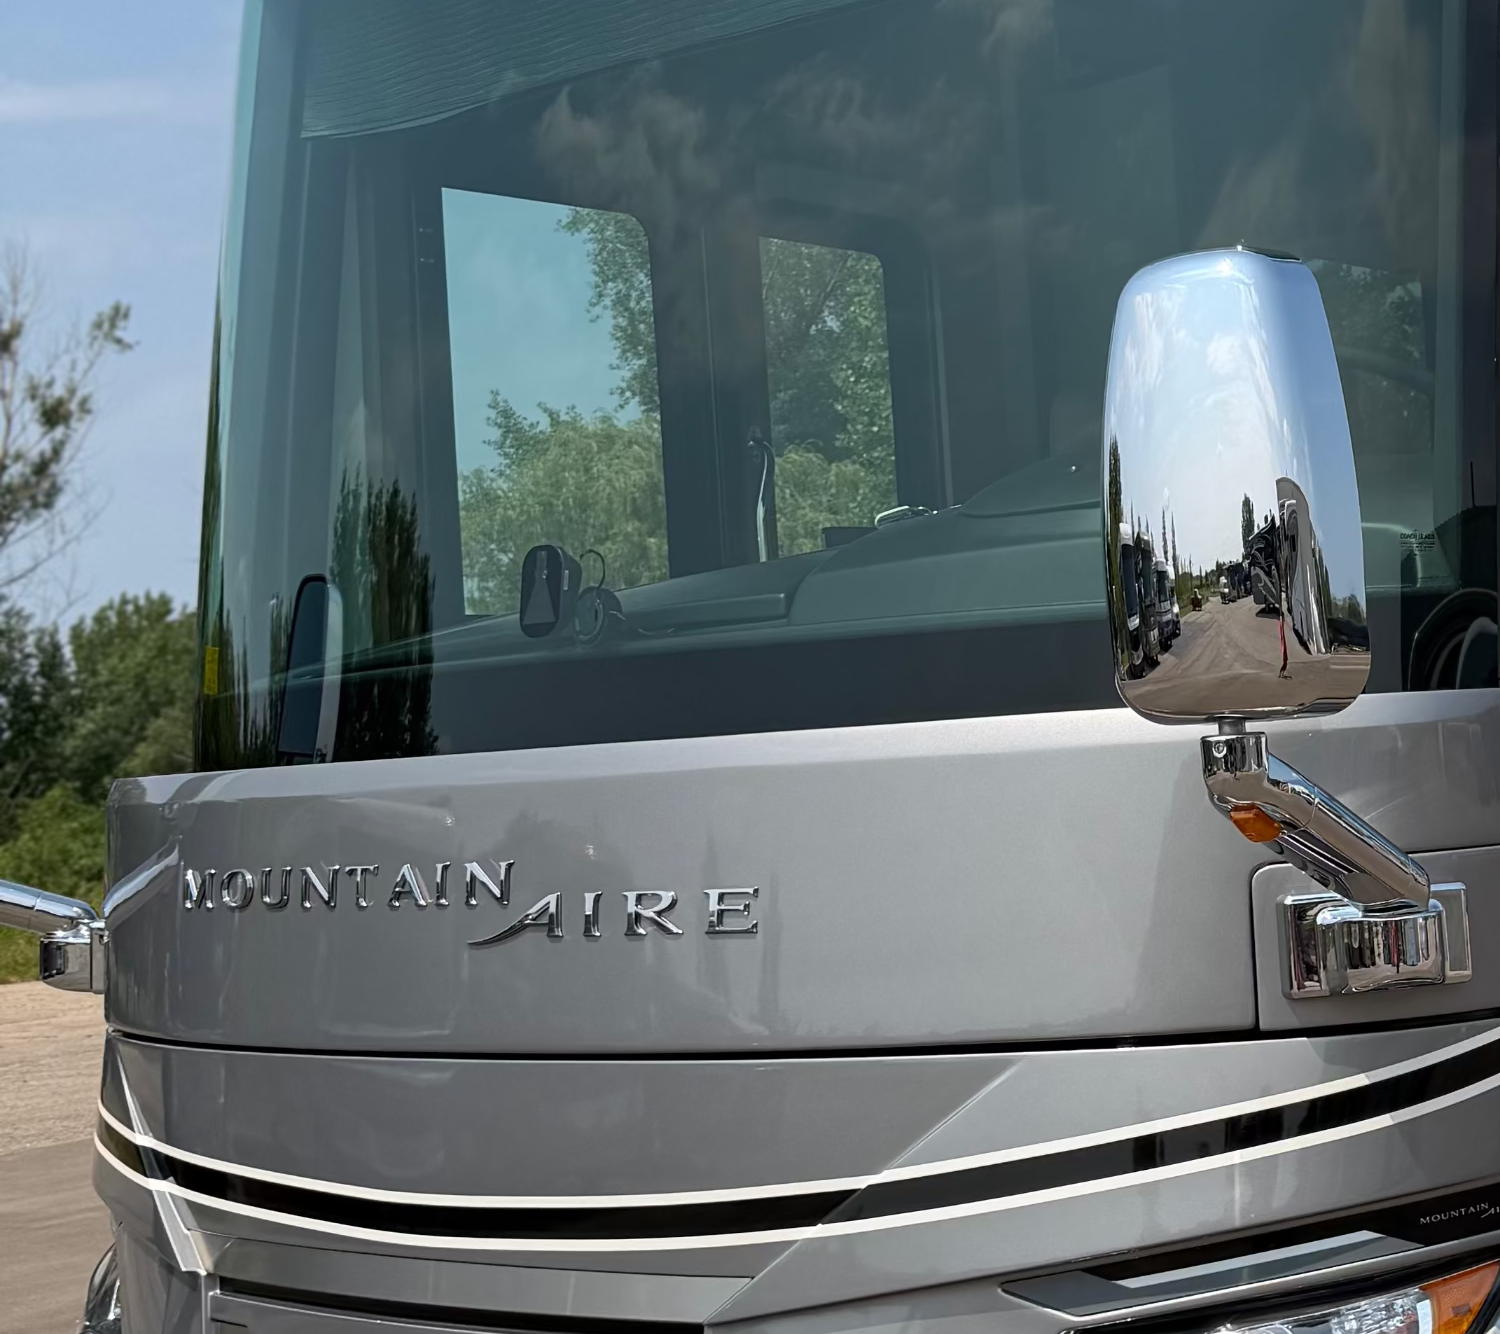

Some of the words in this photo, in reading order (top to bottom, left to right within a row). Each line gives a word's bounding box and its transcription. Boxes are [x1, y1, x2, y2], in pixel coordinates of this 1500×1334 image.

[183, 859, 516, 913] MOUNTAIN
[466, 886, 760, 947] AIRE
[1420, 1202, 1489, 1225] MOUNTAIN
